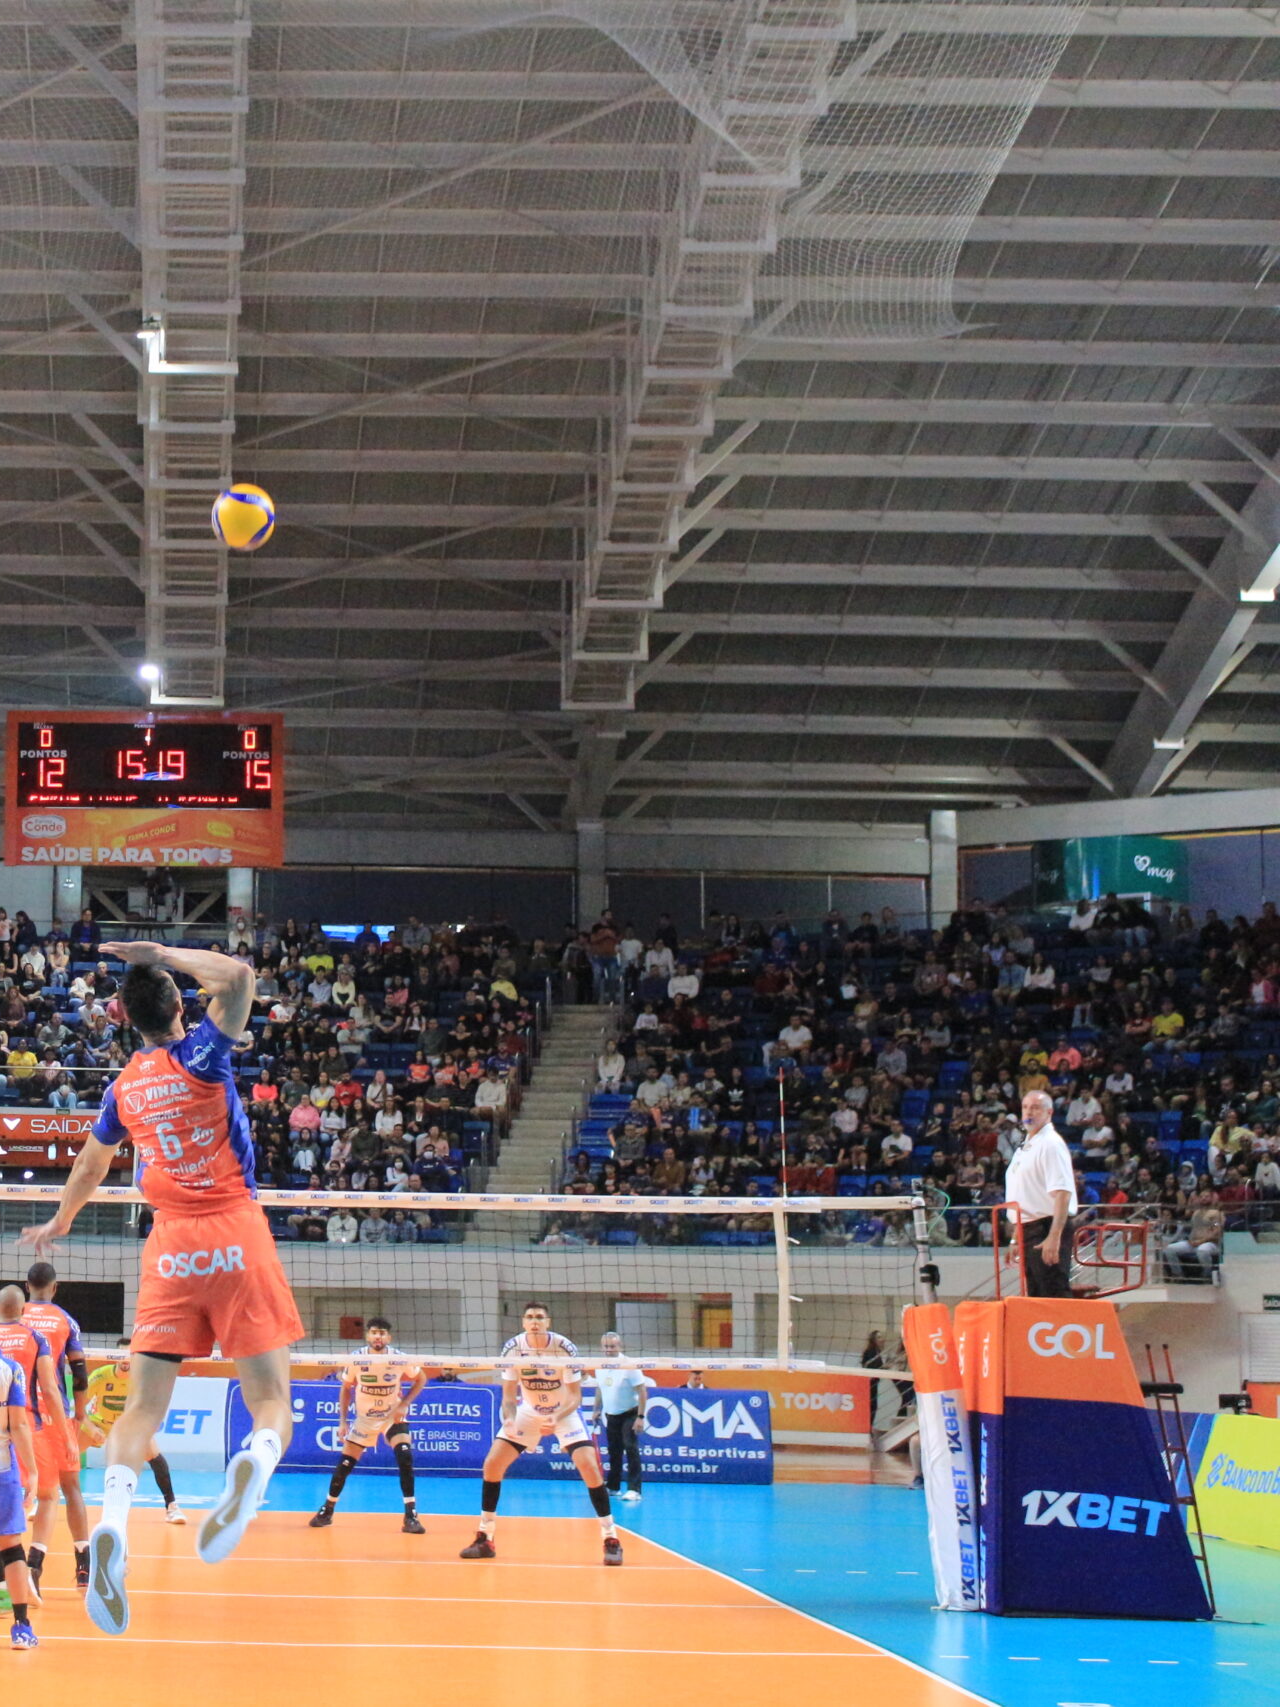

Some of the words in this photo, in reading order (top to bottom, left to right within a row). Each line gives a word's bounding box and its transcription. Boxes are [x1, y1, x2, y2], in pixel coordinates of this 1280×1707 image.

[20, 749, 68, 758] PONTOS
[117, 750, 185, 779] 15:19
[222, 751, 270, 760] PONTOS
[39, 759, 65, 787] 12
[246, 760, 271, 789] 15
[24, 821, 63, 833] Conde
[21, 844, 92, 863] SAÚDE
[98, 848, 154, 863] PARA
[30, 1118, 93, 1133] SAÍDA
[156, 1122, 184, 1160] 6
[157, 1245, 245, 1279] OSCAR
[928, 1328, 948, 1365] GOL
[1027, 1321, 1115, 1359] GOL
[420, 1404, 481, 1417] ATLETAS
[941, 1394, 963, 1454] 1XBET
[417, 1441, 460, 1452] CLUBES
[428, 1431, 481, 1441] BRASILEIRO
[678, 1446, 766, 1460] Esportivas
[951, 1466, 971, 1527] 1XBET
[1022, 1490, 1170, 1536] 1XBET
[960, 1539, 975, 1600] 1XBET
